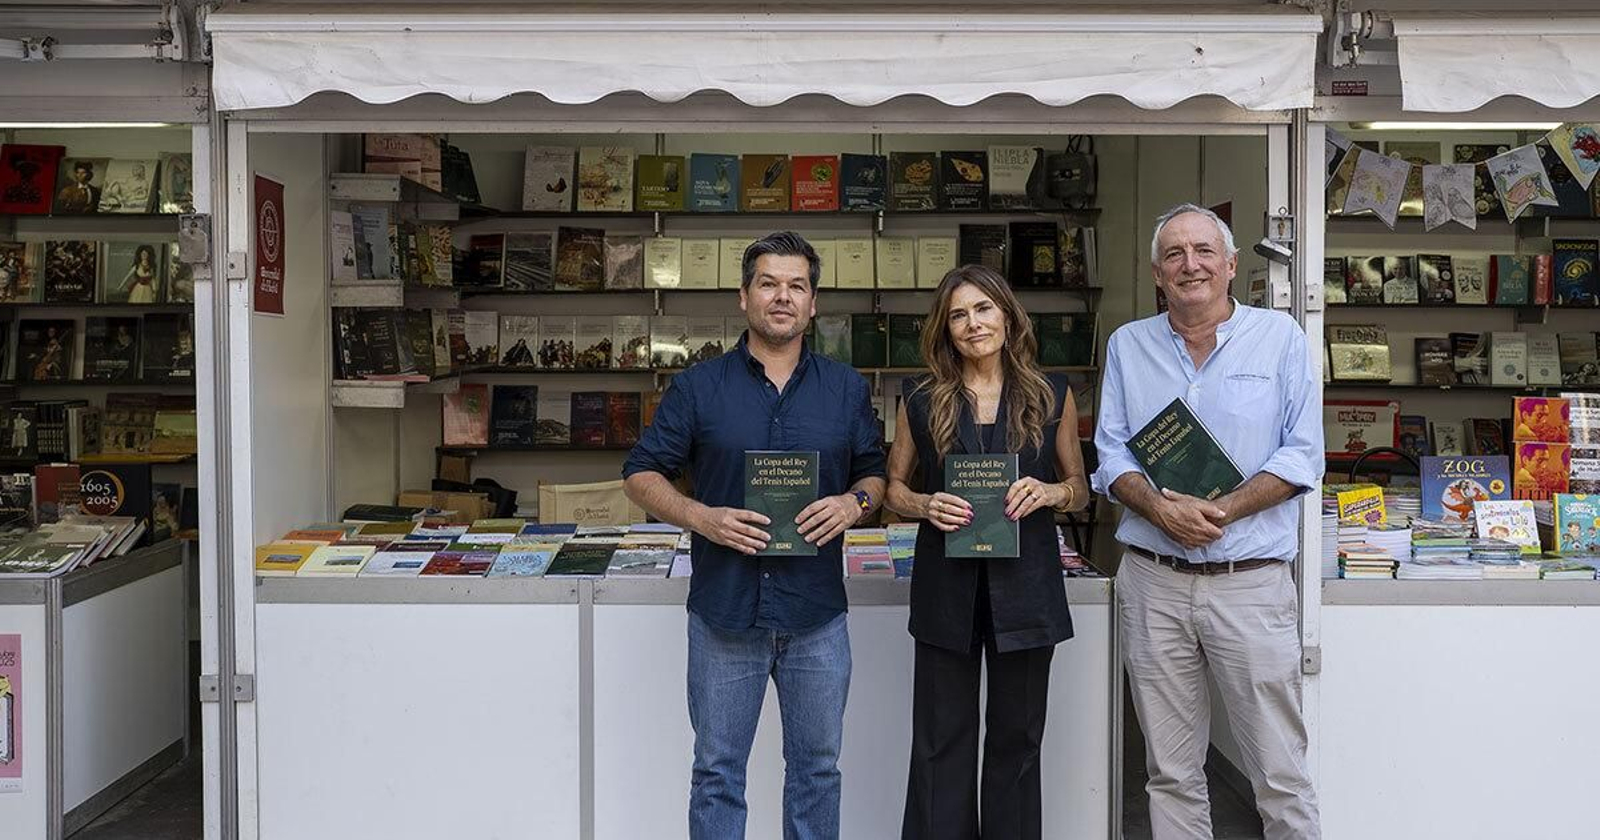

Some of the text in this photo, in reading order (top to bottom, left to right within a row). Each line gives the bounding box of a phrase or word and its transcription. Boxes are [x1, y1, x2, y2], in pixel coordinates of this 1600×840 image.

[993, 148, 1030, 157] ILIPLA
[993, 157, 1030, 165] NIEBLA
[1136, 411, 1178, 449] La Copa del Rey
[1147, 444, 1156, 453] en
[1159, 421, 1181, 443] Decano
[1147, 455, 1157, 466] del
[1155, 442, 1174, 460] Tenis
[1170, 422, 1194, 446] Español
[754, 457, 808, 468] La Copa del Rey
[954, 460, 1006, 470] La Copa del Rey
[1443, 459, 1486, 474] ZOG
[769, 468, 776, 476] el
[776, 468, 803, 476] Decano
[968, 470, 975, 478] el
[976, 470, 1002, 478] Decano
[751, 477, 811, 487] del Tenis Español
[950, 479, 1010, 489] del Tenis Español
[80, 479, 111, 496] 1605
[86, 495, 119, 509] 2005
